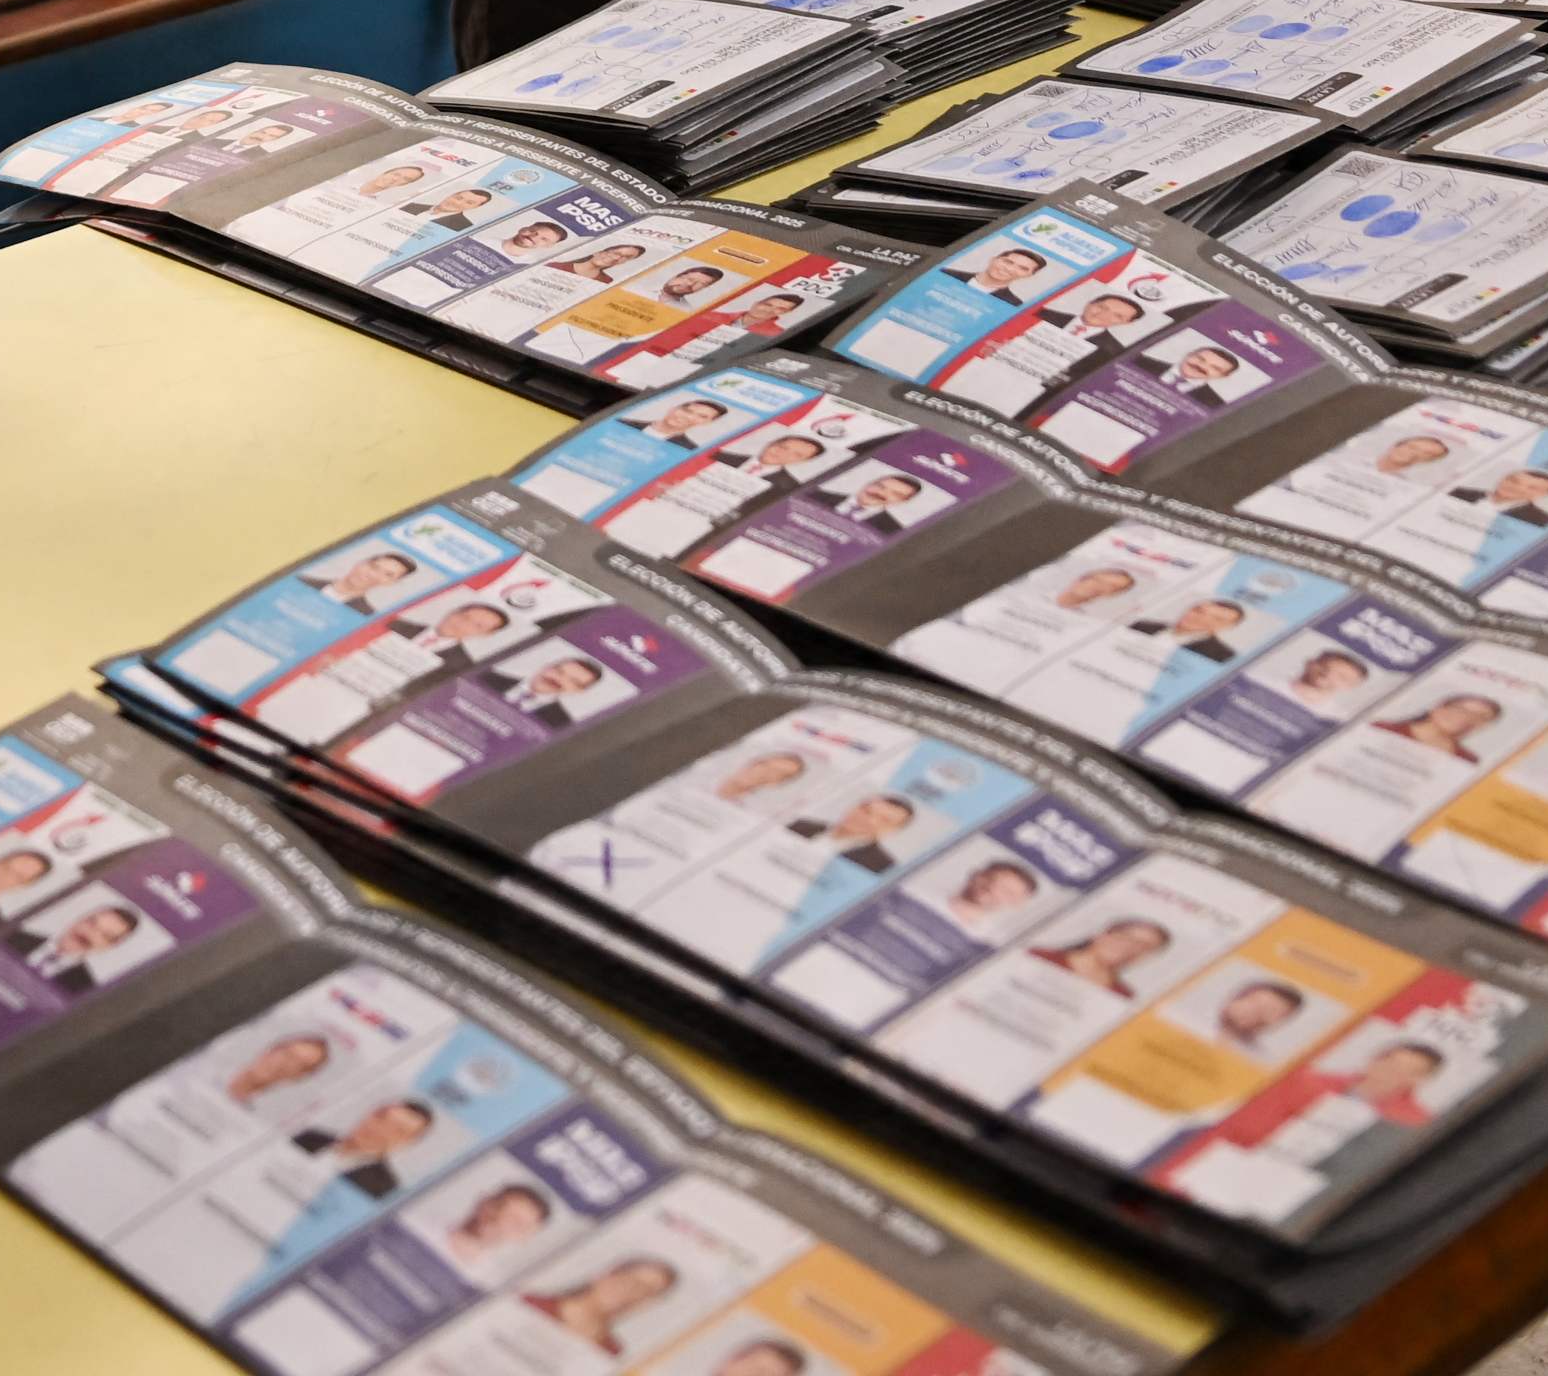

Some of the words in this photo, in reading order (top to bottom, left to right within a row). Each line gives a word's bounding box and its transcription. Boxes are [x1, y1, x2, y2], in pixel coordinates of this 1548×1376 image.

[571, 194, 626, 228] MAS
[583, 150, 612, 174] DEL
[610, 163, 669, 206] ESTADO
[770, 212, 808, 229] 2025
[1212, 251, 1297, 308] ELECCIÓN
[1295, 300, 1326, 324] DE
[904, 389, 991, 430] ELECCIÓN
[990, 420, 1019, 442] DE
